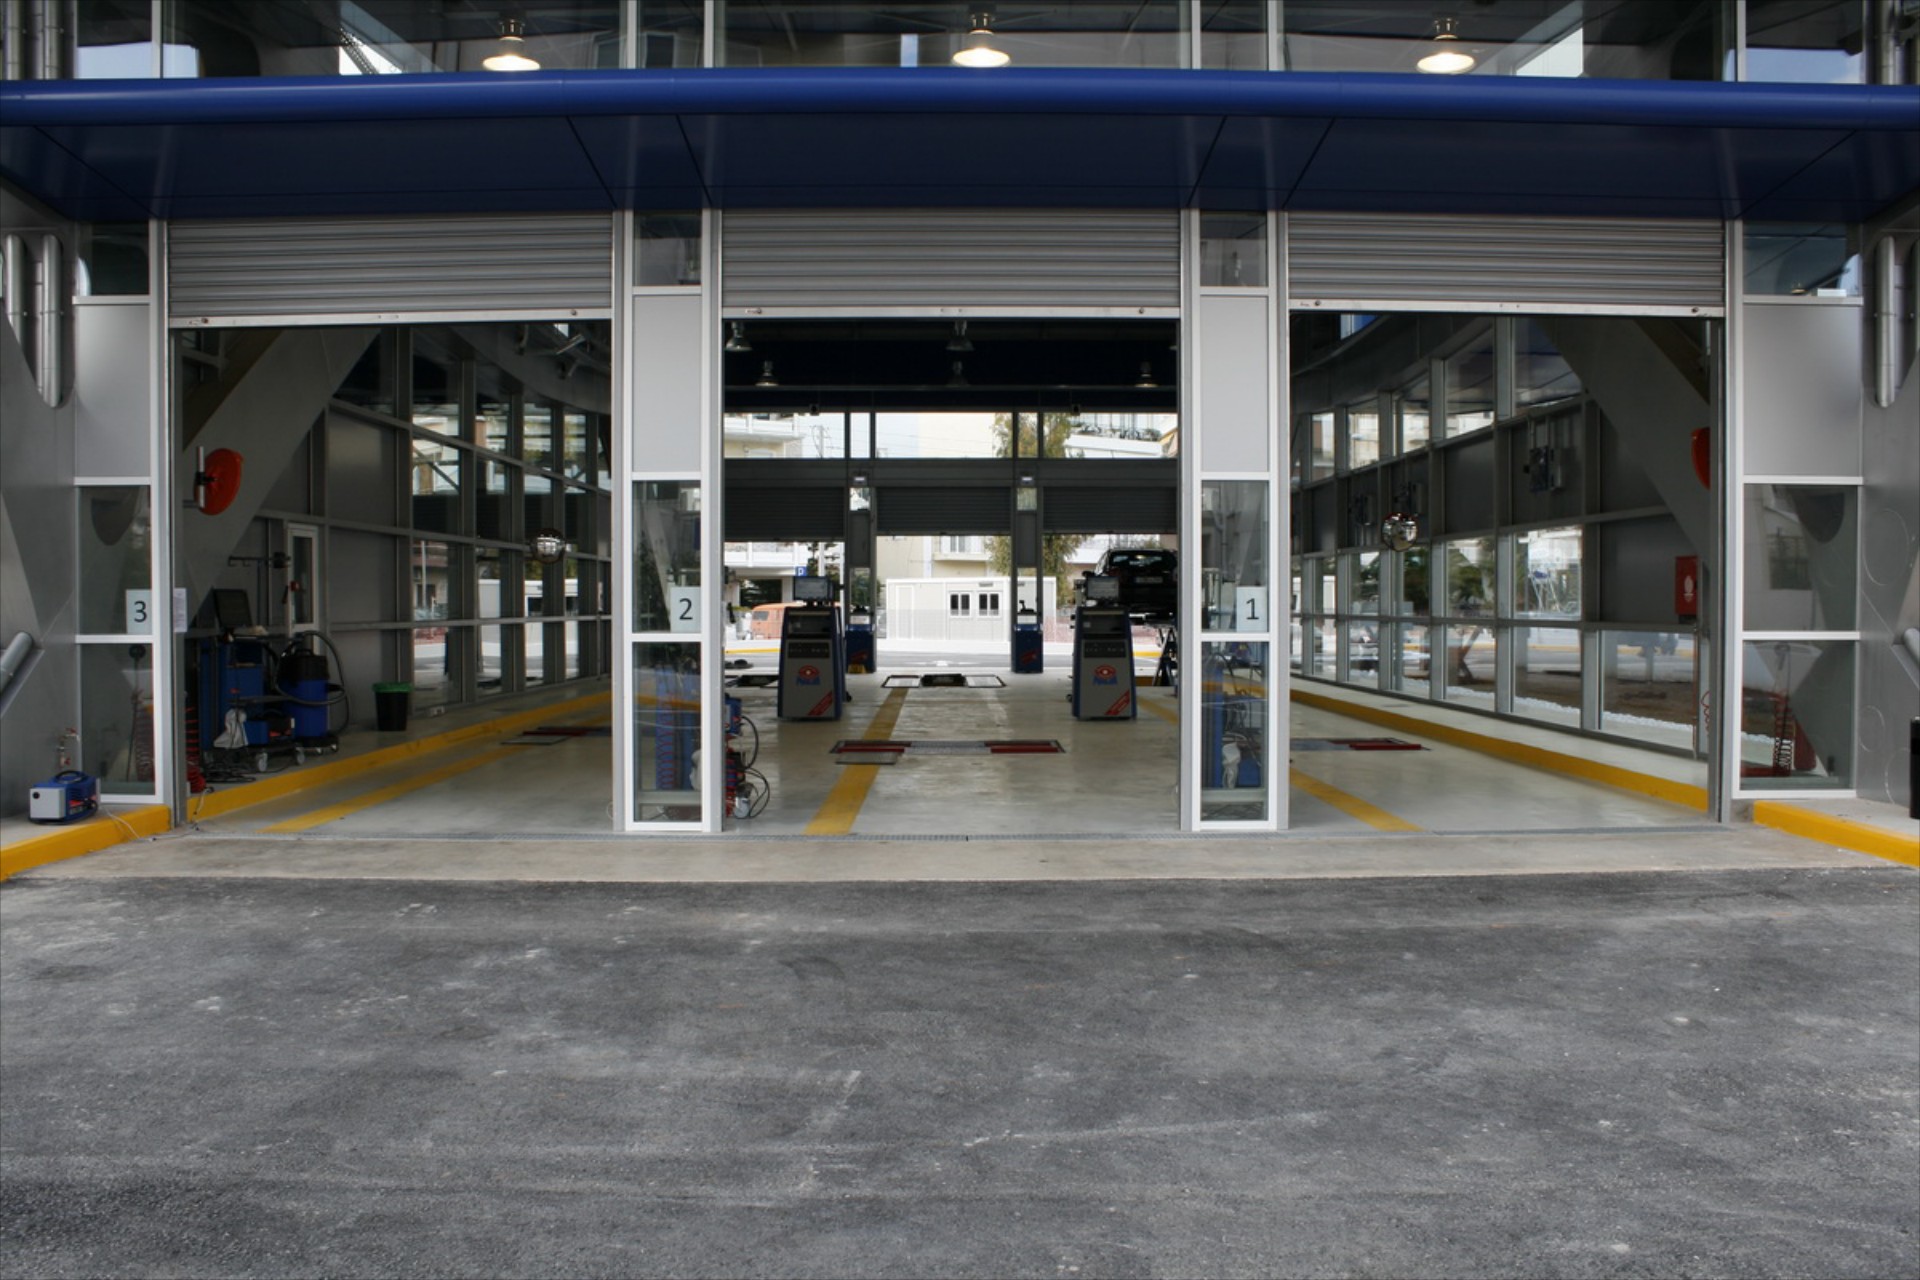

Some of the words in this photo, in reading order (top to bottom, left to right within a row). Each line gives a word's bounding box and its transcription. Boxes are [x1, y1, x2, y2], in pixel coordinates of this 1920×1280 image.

[134, 600, 147, 623] 3
[679, 598, 693, 620] 2
[1246, 598, 1259, 620] 1
